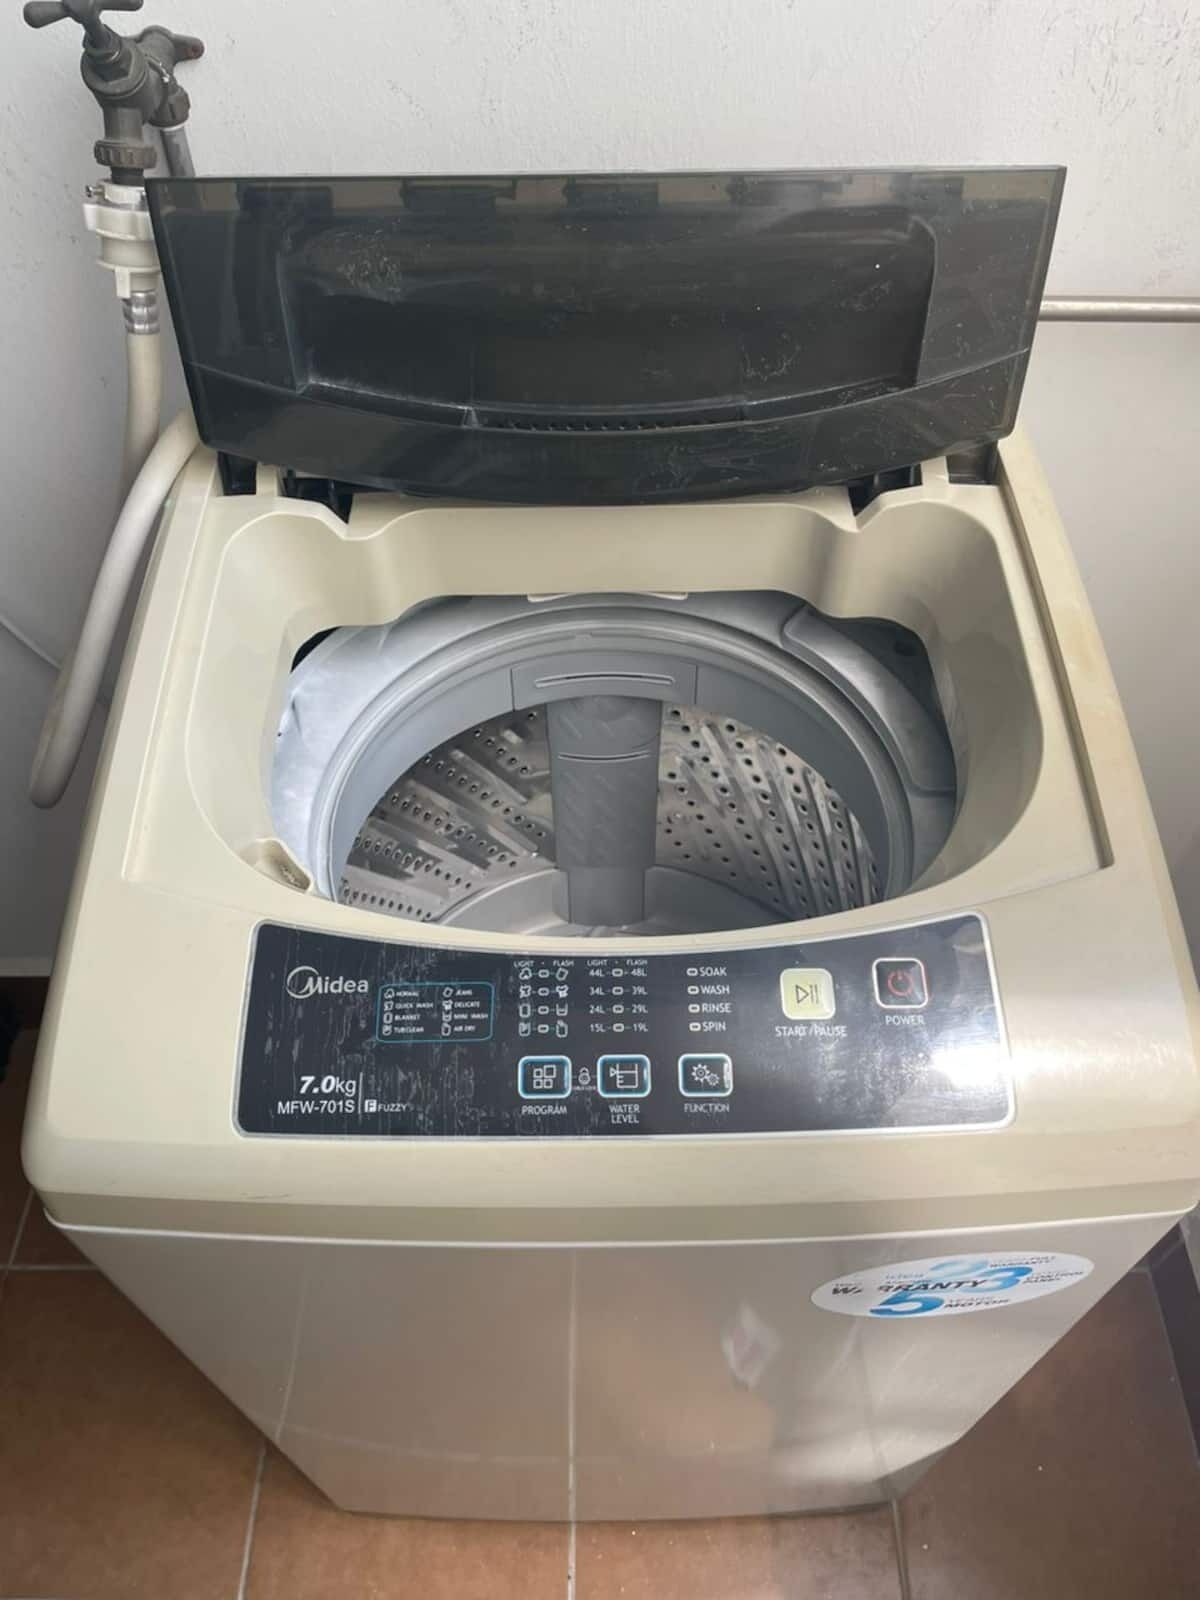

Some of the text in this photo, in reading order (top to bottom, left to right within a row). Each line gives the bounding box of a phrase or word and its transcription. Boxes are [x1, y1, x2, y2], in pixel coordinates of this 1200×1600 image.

[589, 968, 647, 977] 44L 48L
[699, 966, 728, 977] SOAK
[288, 967, 369, 998] Midea
[589, 986, 648, 996] 34L 39L
[700, 985, 730, 995] WASH
[589, 1004, 648, 1014] 24L 29L
[701, 1003, 731, 1013] RINSE
[885, 1014, 925, 1025] POWER
[590, 1023, 648, 1032] 15L 19L
[702, 1021, 726, 1032] SPIN
[299, 1074, 357, 1097] 7.0kg
[277, 1099, 355, 1115] MFW-701S
[377, 1103, 408, 1112] FUZZY
[521, 1104, 567, 1115] PROGRAM
[608, 1104, 640, 1114] WATER
[683, 1103, 730, 1113] FUNCTION
[611, 1114, 639, 1124] LEVEL
[960, 1266, 1033, 1293] 3
[869, 1287, 945, 1316] 5
